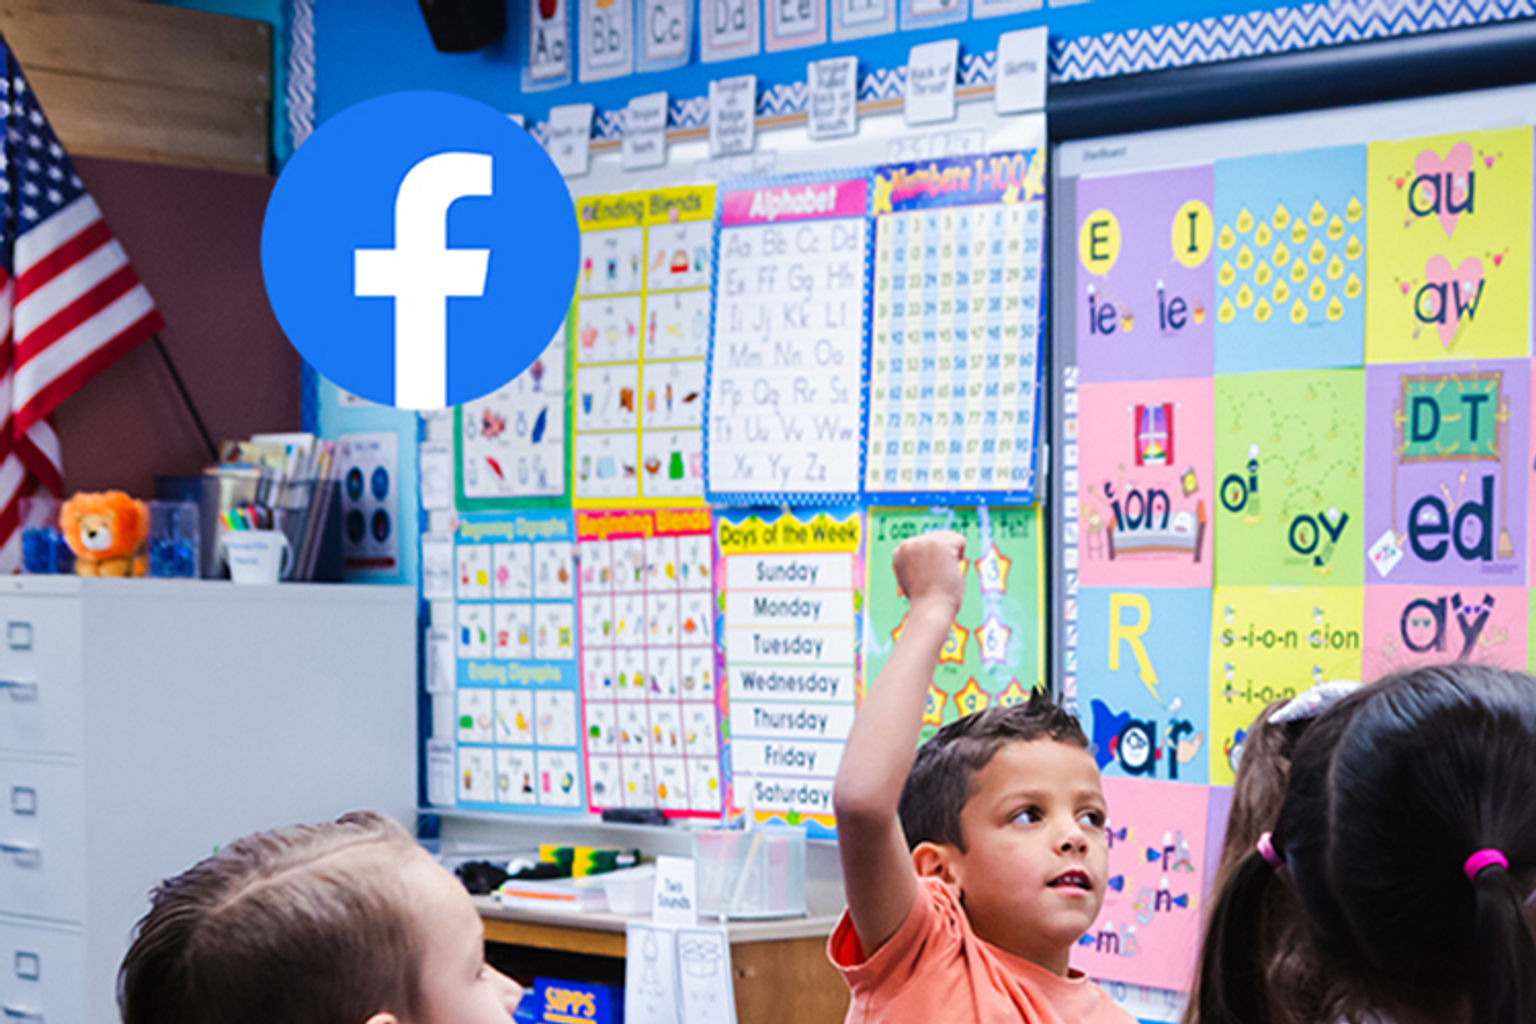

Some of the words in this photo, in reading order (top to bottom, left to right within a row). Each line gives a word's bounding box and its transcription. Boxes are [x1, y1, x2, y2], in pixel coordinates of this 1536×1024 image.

[651, 4, 682, 43] Cc
[591, 198, 644, 224] Ending
[650, 192, 702, 214] Blends
[749, 187, 837, 221] Alphabet
[1408, 170, 1475, 217] au
[1090, 220, 1110, 262] E
[1186, 211, 1199, 253] I
[1087, 294, 1117, 335] ie
[1157, 287, 1188, 331] ie
[1414, 277, 1485, 325] aw
[814, 338, 845, 367] Oo
[1219, 459, 1260, 513] oi
[1104, 481, 1171, 532] ion
[1408, 475, 1495, 563] ed
[720, 525, 757, 549] Days
[762, 523, 778, 545] of
[783, 524, 808, 544] the
[813, 524, 857, 544] Week
[877, 516, 887, 541] I
[890, 521, 917, 540] can
[1288, 511, 1350, 568] oy
[756, 561, 819, 586] Sunday
[753, 597, 822, 622] Monday
[1401, 593, 1496, 662] ay
[753, 633, 824, 659] Tuesday
[1109, 592, 1165, 708] R
[740, 670, 840, 697] Wednesday
[753, 707, 828, 734] Thursday
[764, 745, 816, 771] Friday
[1117, 718, 1194, 780] ar
[754, 781, 831, 810] Saturday
[657, 893, 692, 910] Sounds
[544, 986, 596, 1018] SIPPS
